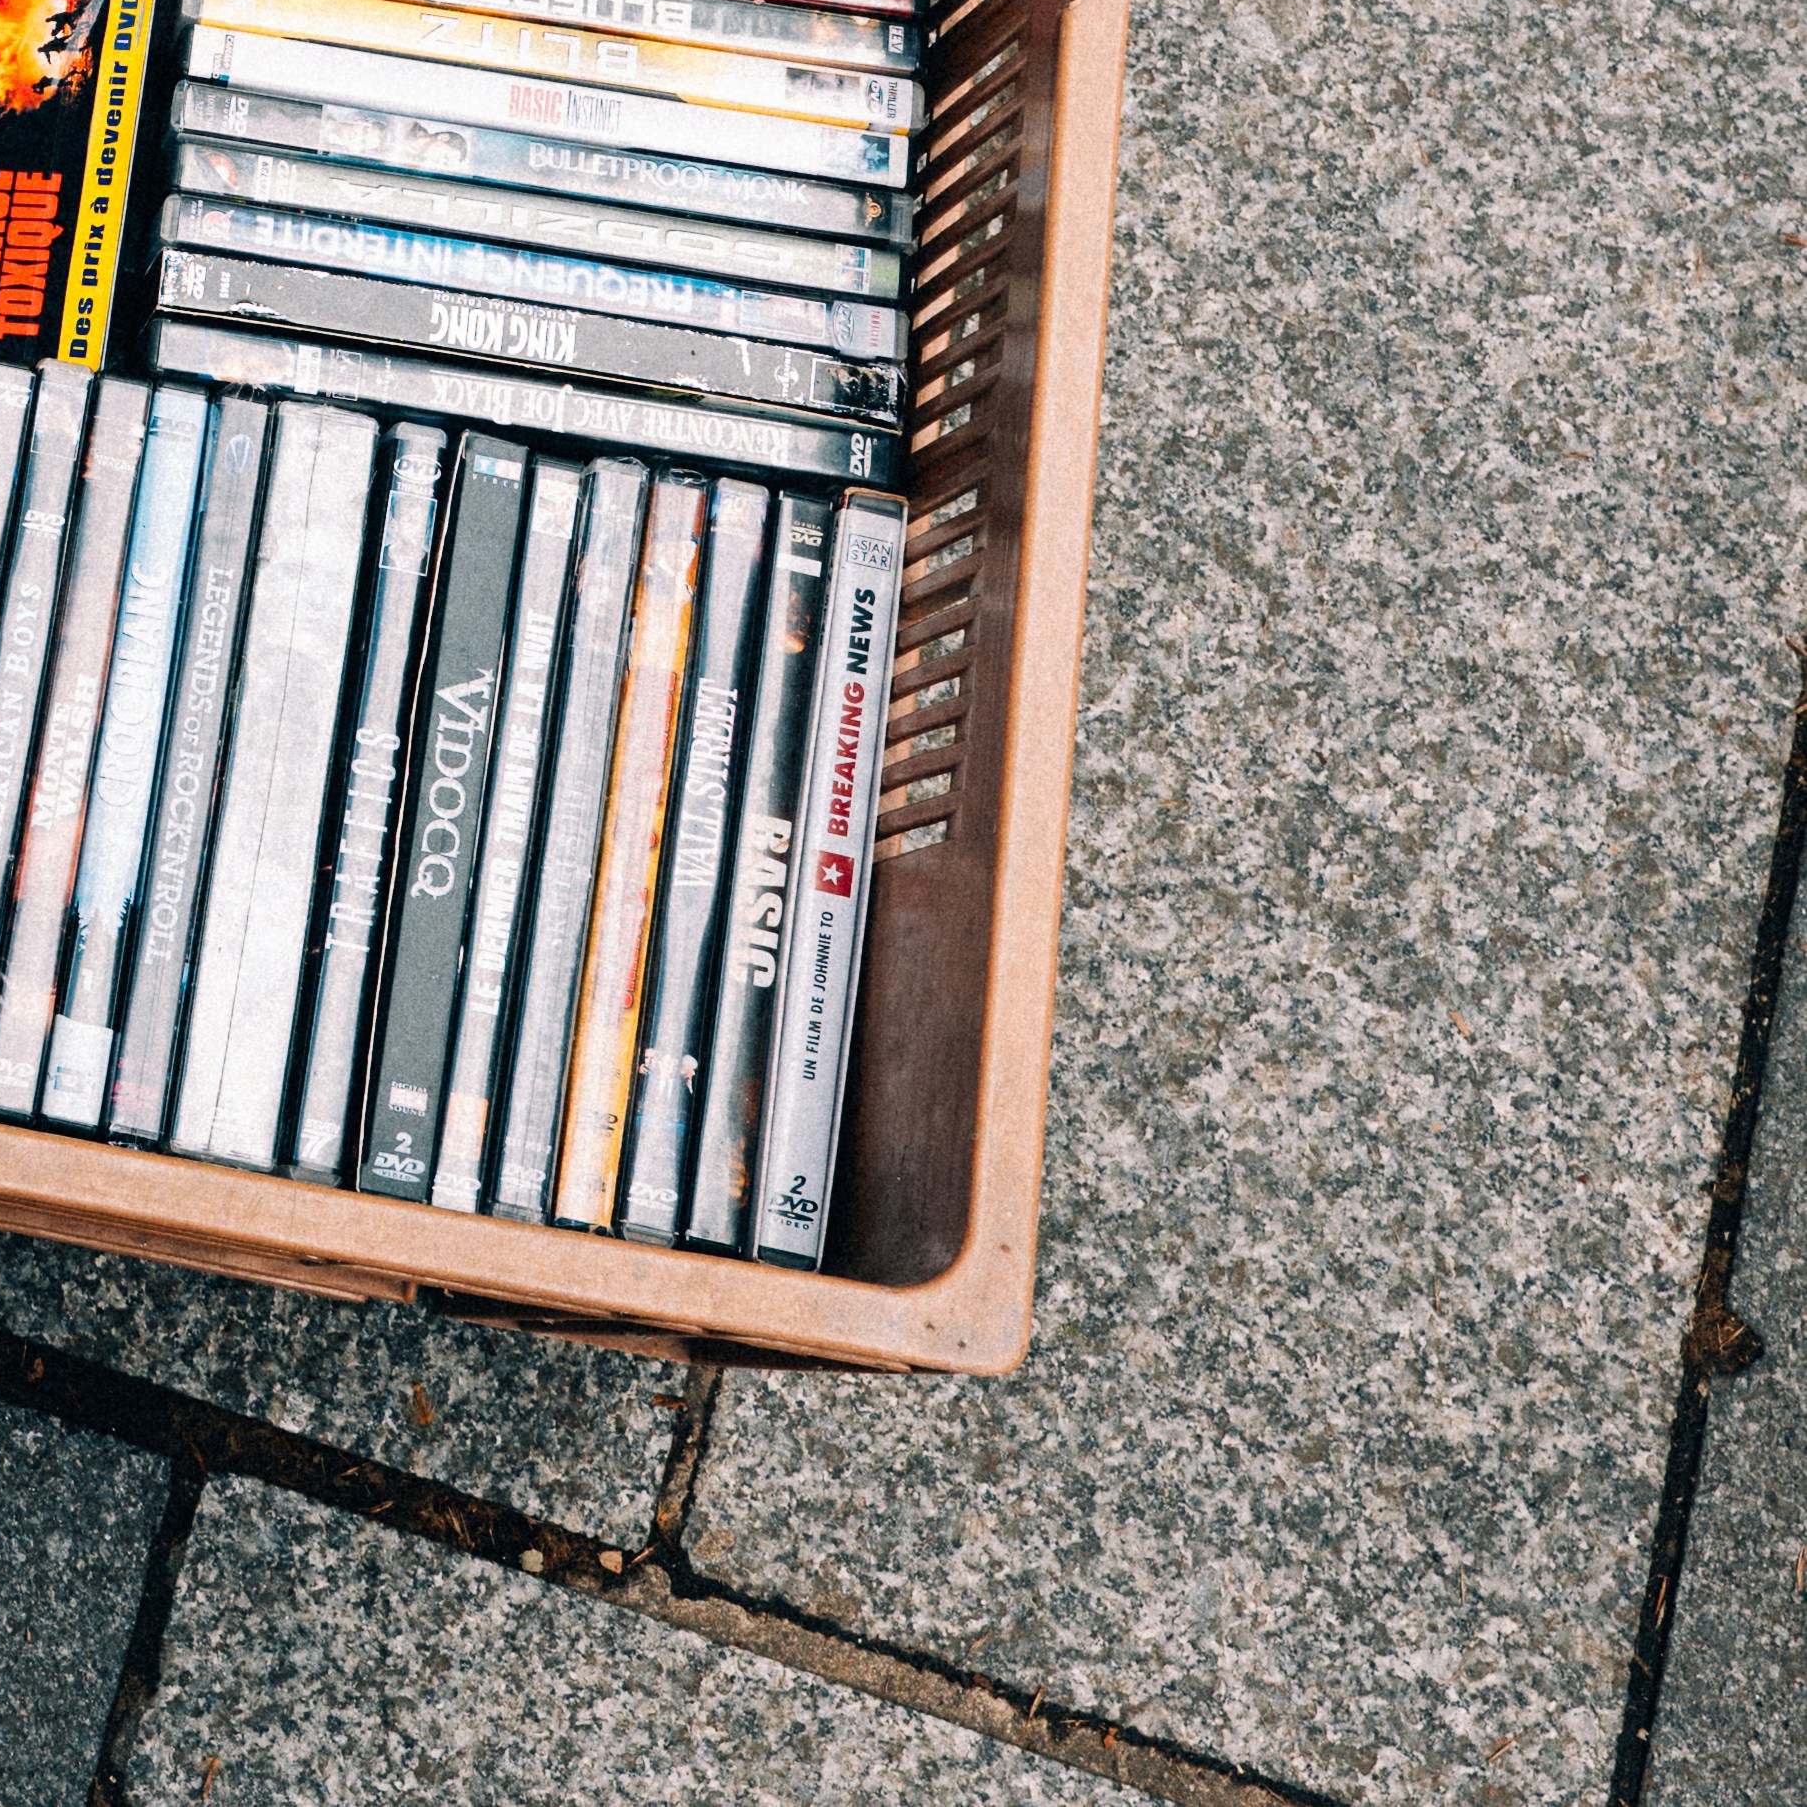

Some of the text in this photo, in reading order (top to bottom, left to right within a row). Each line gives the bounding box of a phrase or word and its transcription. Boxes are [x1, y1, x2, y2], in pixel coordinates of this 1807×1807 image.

[415, 12, 640, 81] BLITZ
[92, 58, 131, 187] devenir
[88, 193, 110, 215] à
[326, 174, 795, 273] GODZILLA
[526, 141, 810, 209] BULLETPROOF MONK
[77, 221, 110, 288] prix
[250, 213, 695, 314] FREQUENCE INTERDITE
[67, 294, 95, 359] Des
[426, 298, 578, 363] KING KONG
[425, 372, 793, 467] RENCONTRE AVEC JOE BLACK
[2, 579, 45, 677] BOYS
[55, 671, 100, 820] WALSH
[827, 585, 876, 838] BREAKING NEWS
[406, 662, 495, 905] VIDOCQ
[469, 606, 555, 1016] LE DERNIER TRAIN DE LA NUIT
[672, 676, 740, 892] WALL STREET
[323, 724, 403, 956] TRAFFICS
[732, 813, 793, 990] BASIC
[802, 909, 834, 1079] UN FILM DE JOHNNIE TO
[788, 1174, 806, 1196] 2
